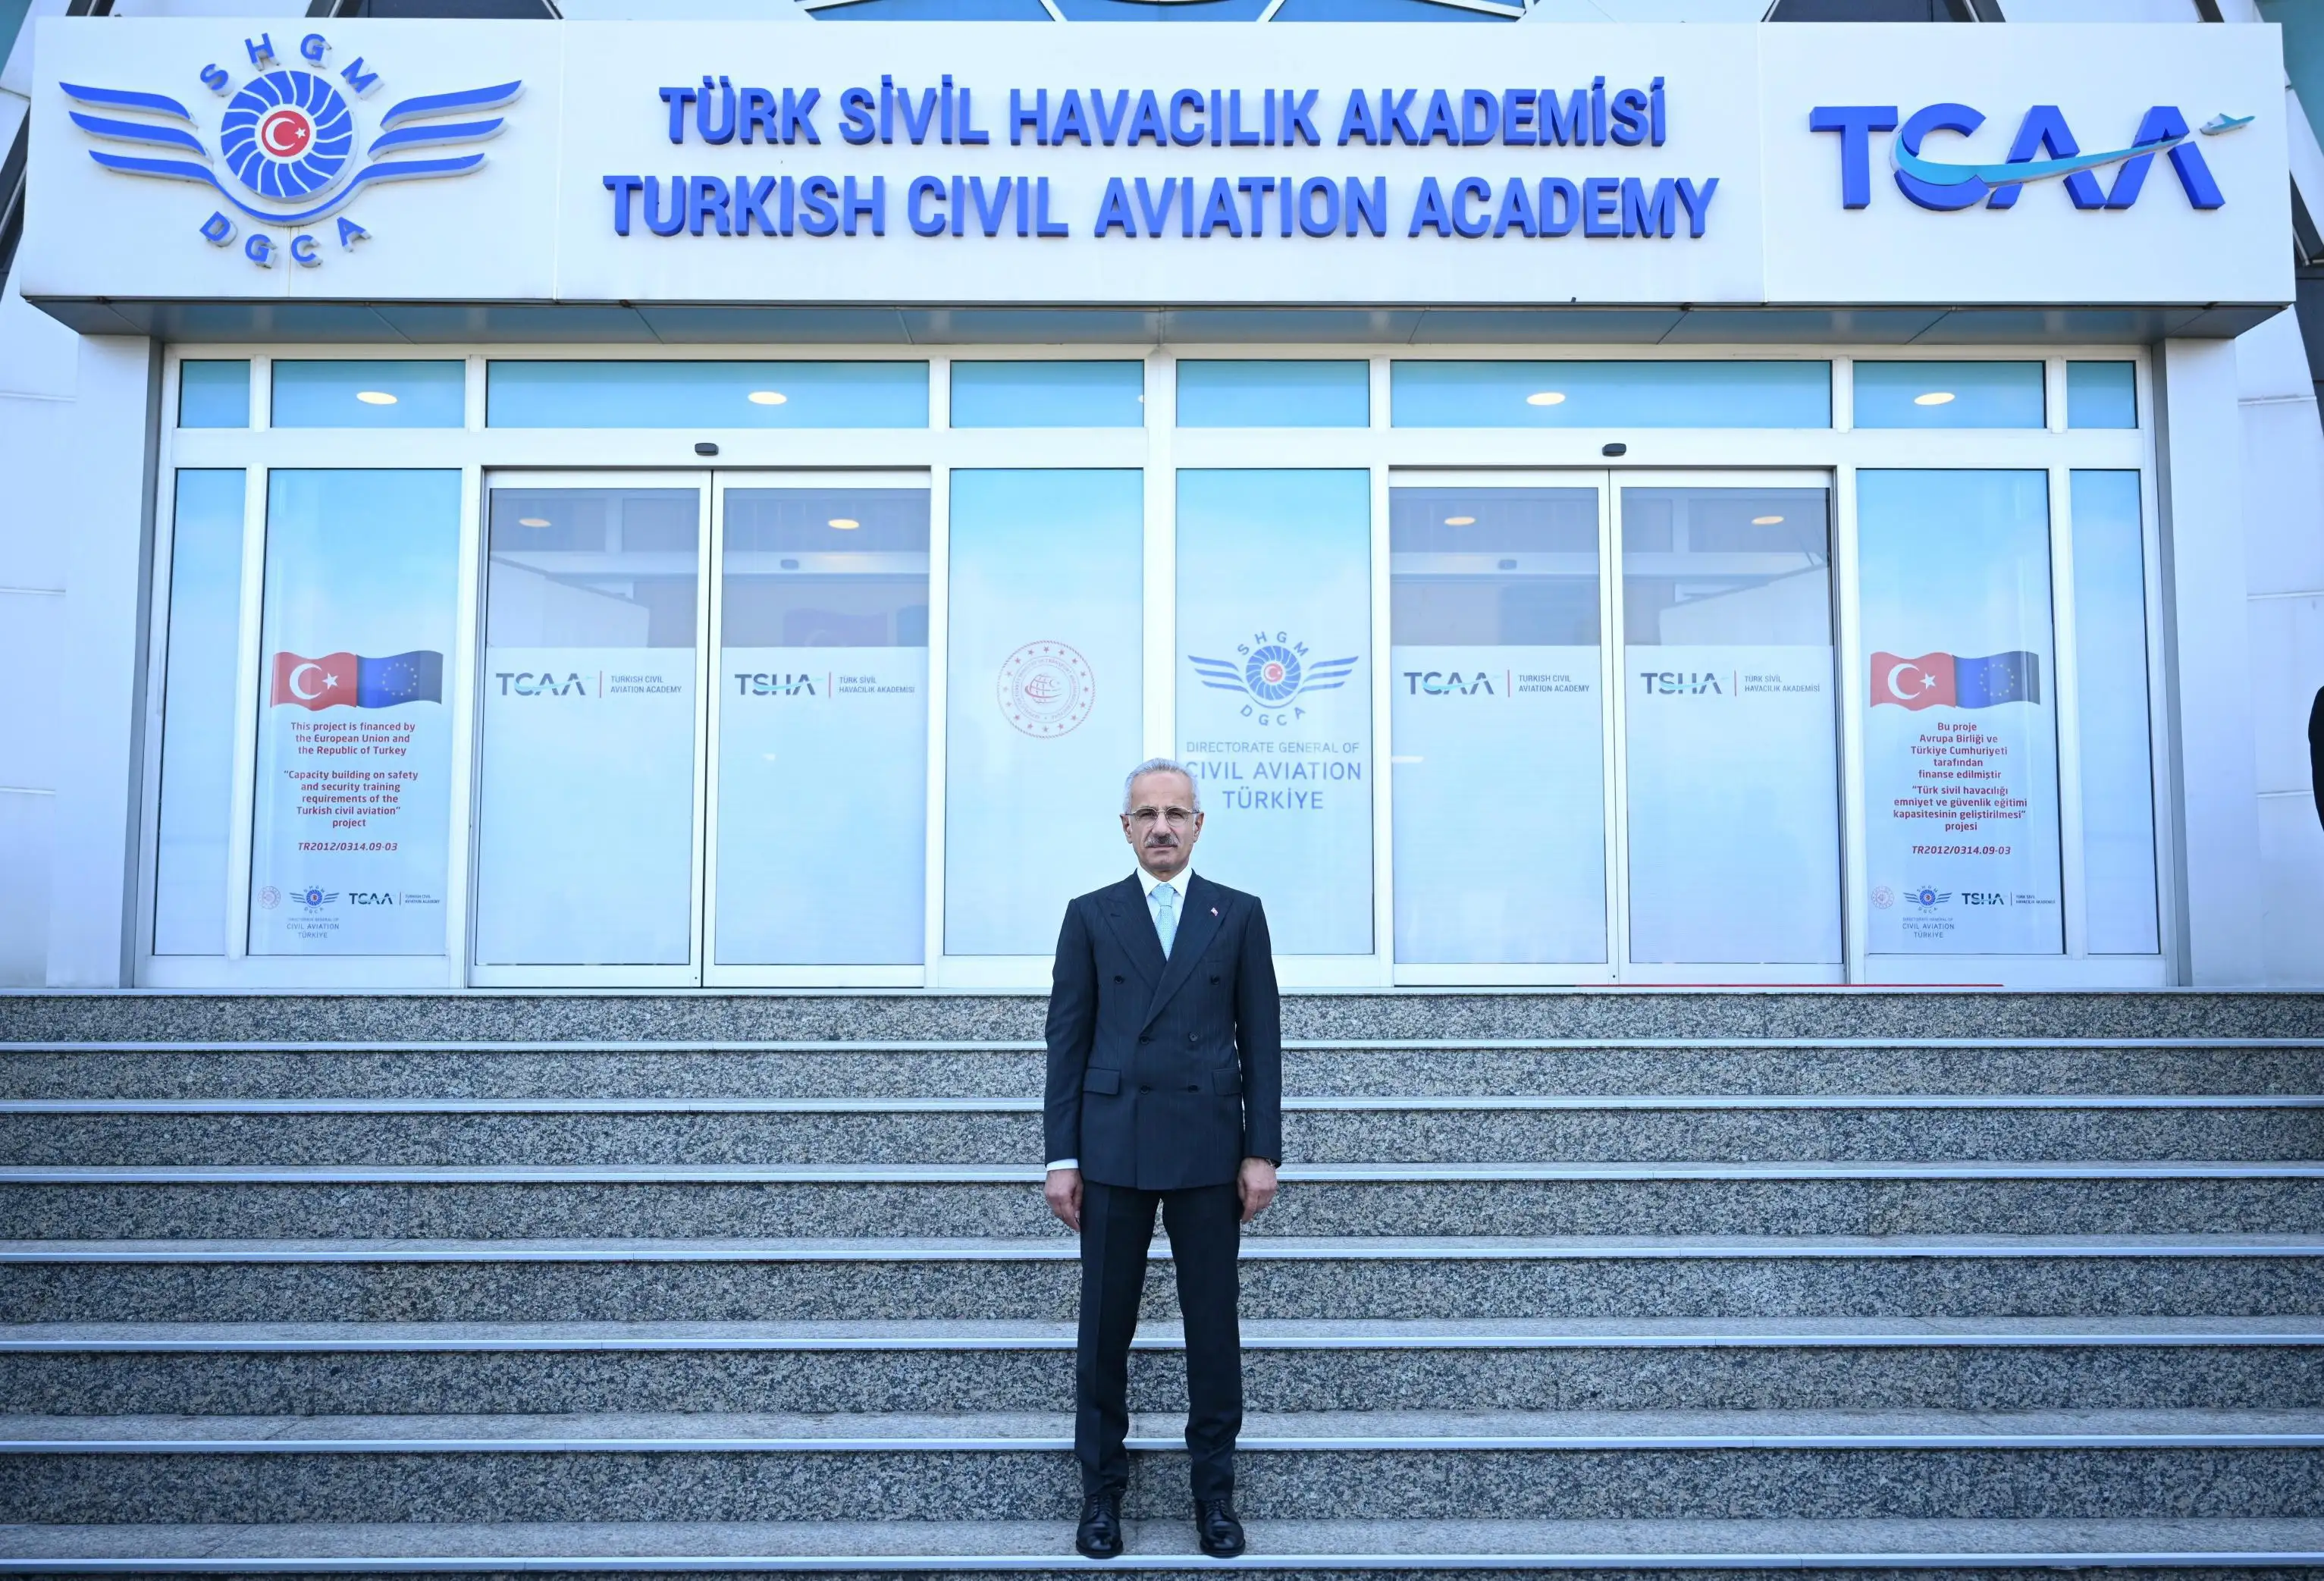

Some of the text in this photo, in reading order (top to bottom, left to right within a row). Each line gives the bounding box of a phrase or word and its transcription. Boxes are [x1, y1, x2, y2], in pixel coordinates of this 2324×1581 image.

[199, 32, 384, 99] SHGM
[660, 74, 1665, 146] TÜRK SİVİL HAVACILIK AKADEMİSİ
[1809, 103, 2225, 212] TCAA
[603, 174, 1720, 239] TURKISH CIVIL AVIATION ACADEMY
[199, 211, 372, 268] DGCA
[1237, 631, 1309, 656] SHGM
[611, 675, 663, 684] TURKISH CIVIL
[1403, 672, 1494, 695] TCAA
[1519, 674, 1571, 682] TURKISH CIVIL
[496, 673, 586, 696] TCAA
[610, 685, 682, 694] AVIATION ACADEMY
[735, 673, 815, 696] TSHA
[1640, 673, 1722, 695] TSHA
[1240, 704, 1306, 726] DGCA
[291, 723, 416, 732] This project is financed by
[1938, 723, 1977, 732] Bu proje
[296, 734, 410, 745] the European Union and
[1920, 735, 1953, 745] Avrupa
[1956, 734, 1984, 745] Birliği
[298, 746, 406, 757] the Republic of Turkey
[1187, 742, 1360, 754] DIRECTORATE GENERAL OF
[1911, 746, 2007, 757] Türkiye Cumhuriyeti
[1934, 758, 1983, 767] tarafından
[331, 770, 371, 781] building
[387, 770, 418, 781] safety
[1254, 761, 1361, 780] AVIATION
[1918, 770, 2002, 781] finanse edilmiştir
[301, 783, 400, 793] and security training
[1941, 786, 1961, 795] sivil
[1963, 786, 2008, 797] havacılığı
[302, 795, 398, 805] requirements of the
[1222, 786, 1323, 810] TÜRKİYE
[1894, 798, 1934, 808] emniyet
[1950, 798, 1991, 808] güvenlik
[1993, 798, 2027, 808] eğitimi
[296, 806, 332, 814] Turkish
[334, 806, 354, 814] civil
[1893, 810, 1957, 820] kapasitesinin
[332, 818, 366, 829] project
[1945, 822, 1977, 833] projesi
[298, 842, 397, 852] TR2012/0314.09-03
[1912, 845, 2011, 855] TR2012/0314.09-03
[349, 893, 393, 904] TCAA
[1962, 893, 2004, 905] TSHA
